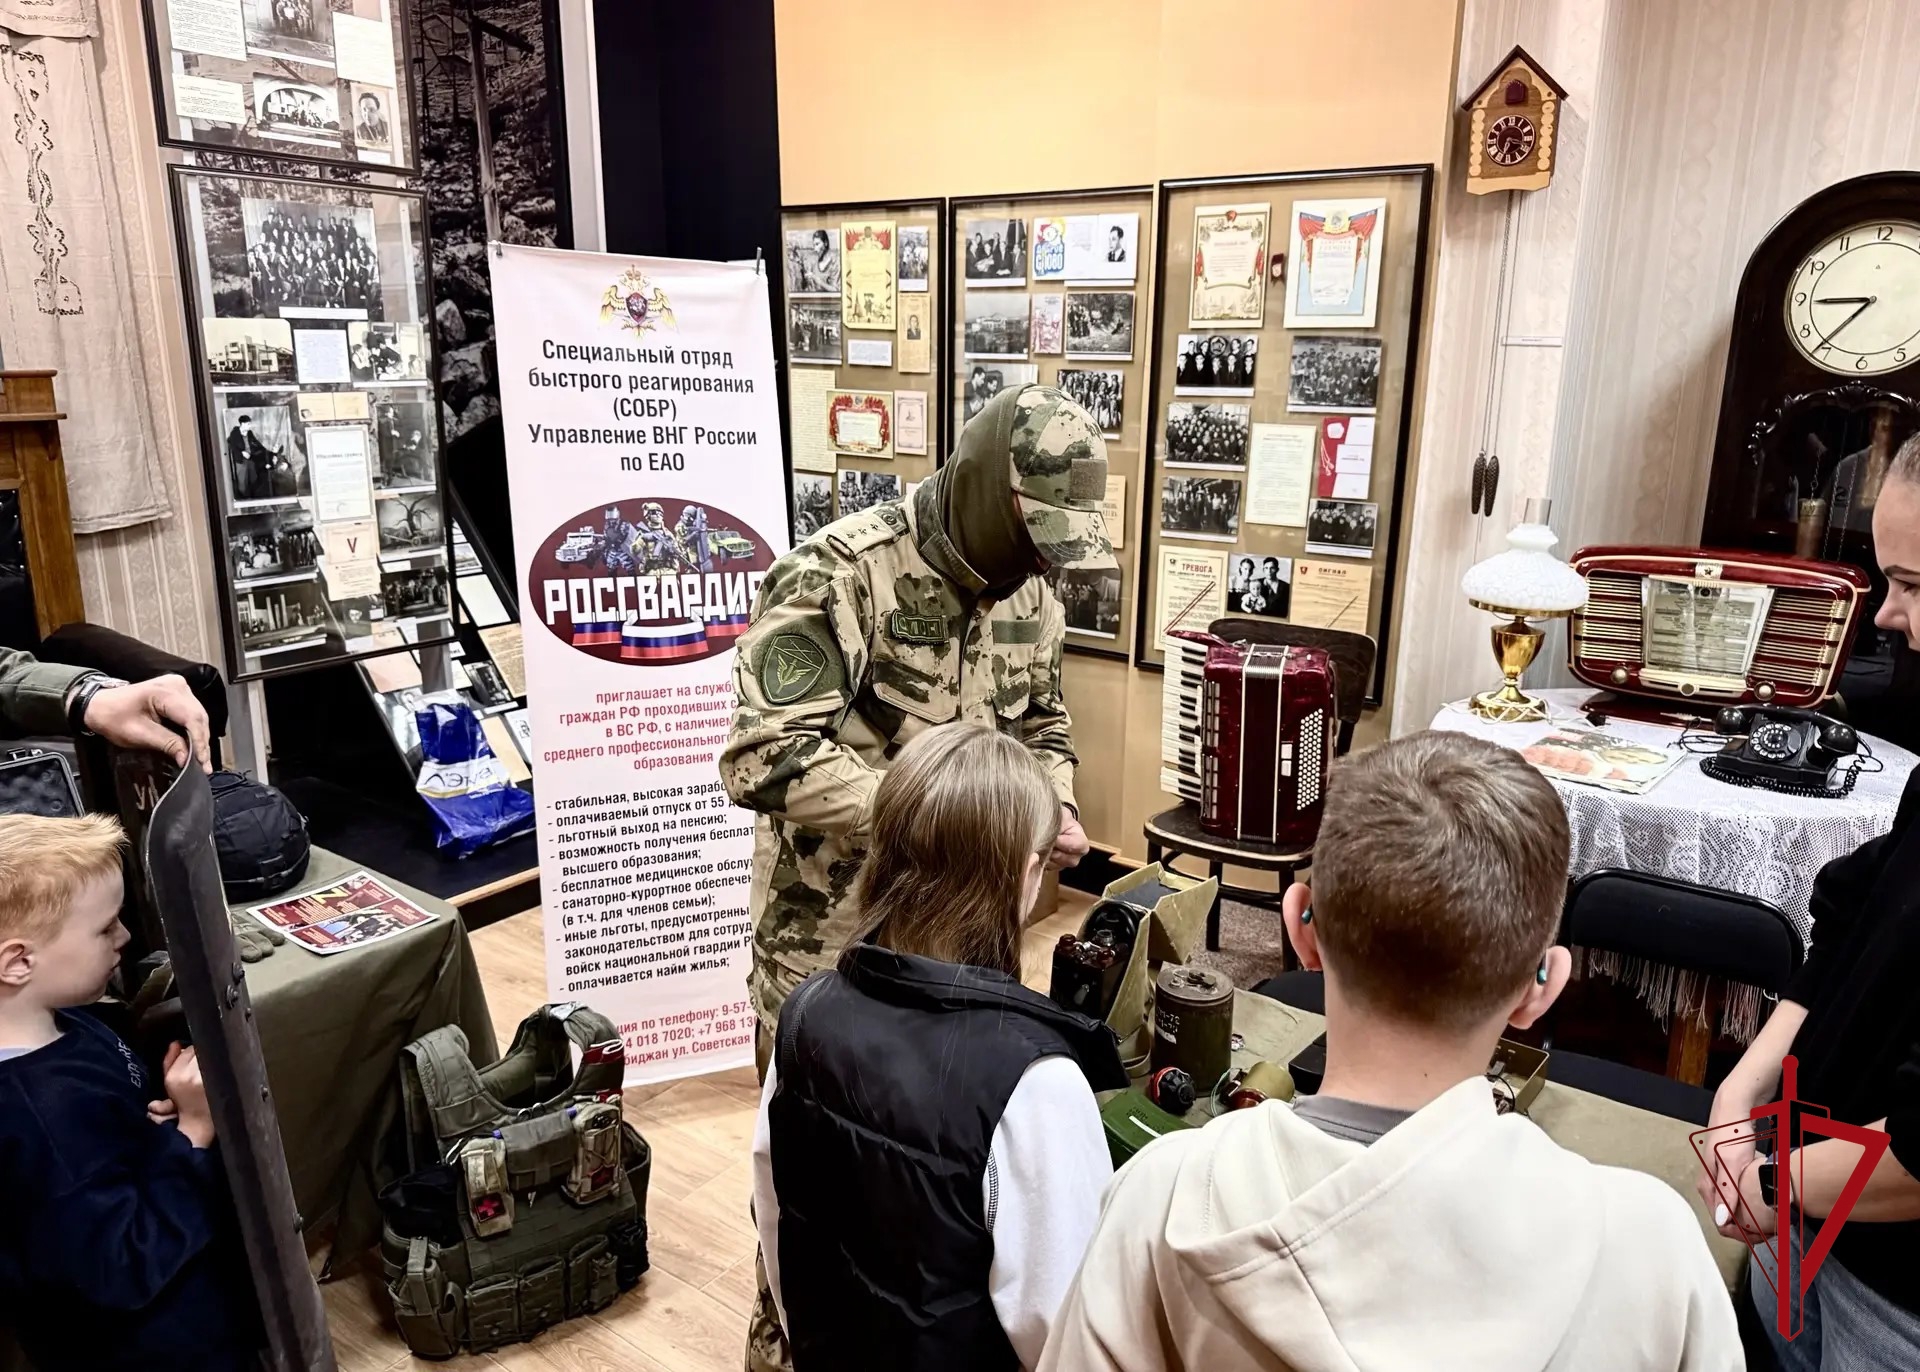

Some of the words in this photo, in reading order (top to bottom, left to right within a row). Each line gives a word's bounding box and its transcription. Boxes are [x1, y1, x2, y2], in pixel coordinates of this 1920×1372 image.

[1840, 236, 1850, 250] 11
[1877, 226, 1893, 240] 12
[1810, 260, 1825, 275] 10
[1794, 292, 1807, 306] 9
[1800, 324, 1811, 338] 8
[542, 339, 675, 364] Специальный
[681, 350, 734, 370] отряд
[1821, 347, 1832, 361] 7
[1856, 356, 1868, 370] 6
[1893, 348, 1906, 362] 5
[528, 367, 622, 392] быстрого
[628, 375, 754, 396] реагирования
[613, 397, 677, 422] (СОБР)
[528, 424, 646, 448] Управление
[652, 426, 688, 444] ВНГ
[694, 426, 757, 445] России
[620, 456, 642, 472] по
[648, 452, 685, 471] ЕАО
[1182, 563, 1212, 573] ТРЕВОГА
[596, 688, 672, 706] приглашает
[676, 686, 691, 696] на
[560, 710, 616, 726] граждан
[619, 706, 640, 719] РФ
[644, 700, 727, 719] проходивших
[606, 728, 613, 738] в
[616, 723, 634, 737] ВС
[638, 721, 662, 735] РФ,
[664, 722, 672, 732] с
[544, 746, 604, 764] среднего
[634, 752, 714, 771] образования
[554, 793, 630, 811] стабильная,
[632, 786, 683, 802] высокая
[556, 804, 649, 827] оплачиваемый
[652, 802, 692, 816] отпуск
[694, 800, 708, 810] от
[711, 796, 724, 808] 55
[557, 825, 617, 844] льготный
[620, 822, 660, 836] выход
[663, 820, 677, 830] на
[680, 814, 727, 828] пенсию;
[558, 841, 641, 860] возможность
[644, 832, 706, 849] получения
[562, 860, 618, 877] высшего
[621, 849, 702, 869] образования;
[561, 874, 632, 894] бесплатное
[636, 863, 714, 883] медицинское
[562, 882, 692, 910] санаторно-курортное
[562, 914, 574, 929] (в
[577, 913, 597, 924] т.ч.
[600, 908, 623, 923] для
[626, 902, 669, 916] членов
[672, 893, 716, 910] семьи);
[564, 929, 597, 943] иные
[600, 922, 648, 938] льготы,
[564, 932, 685, 960] законодательством
[688, 928, 710, 942] для
[566, 961, 601, 976] войск
[604, 945, 690, 970] национальной
[693, 939, 740, 956] гвардии
[568, 969, 653, 992] оплачивается
[656, 963, 687, 978] найм
[690, 957, 730, 972] жилья;
[641, 1019, 656, 1030] по
[659, 1008, 718, 1026] телефону:
[636, 1032, 658, 1047] 018
[662, 1027, 695, 1042] 7020;
[698, 1023, 712, 1036] +7
[715, 1019, 736, 1033] 968
[672, 1046, 689, 1060] ул.
[692, 1034, 750, 1054] Советская
